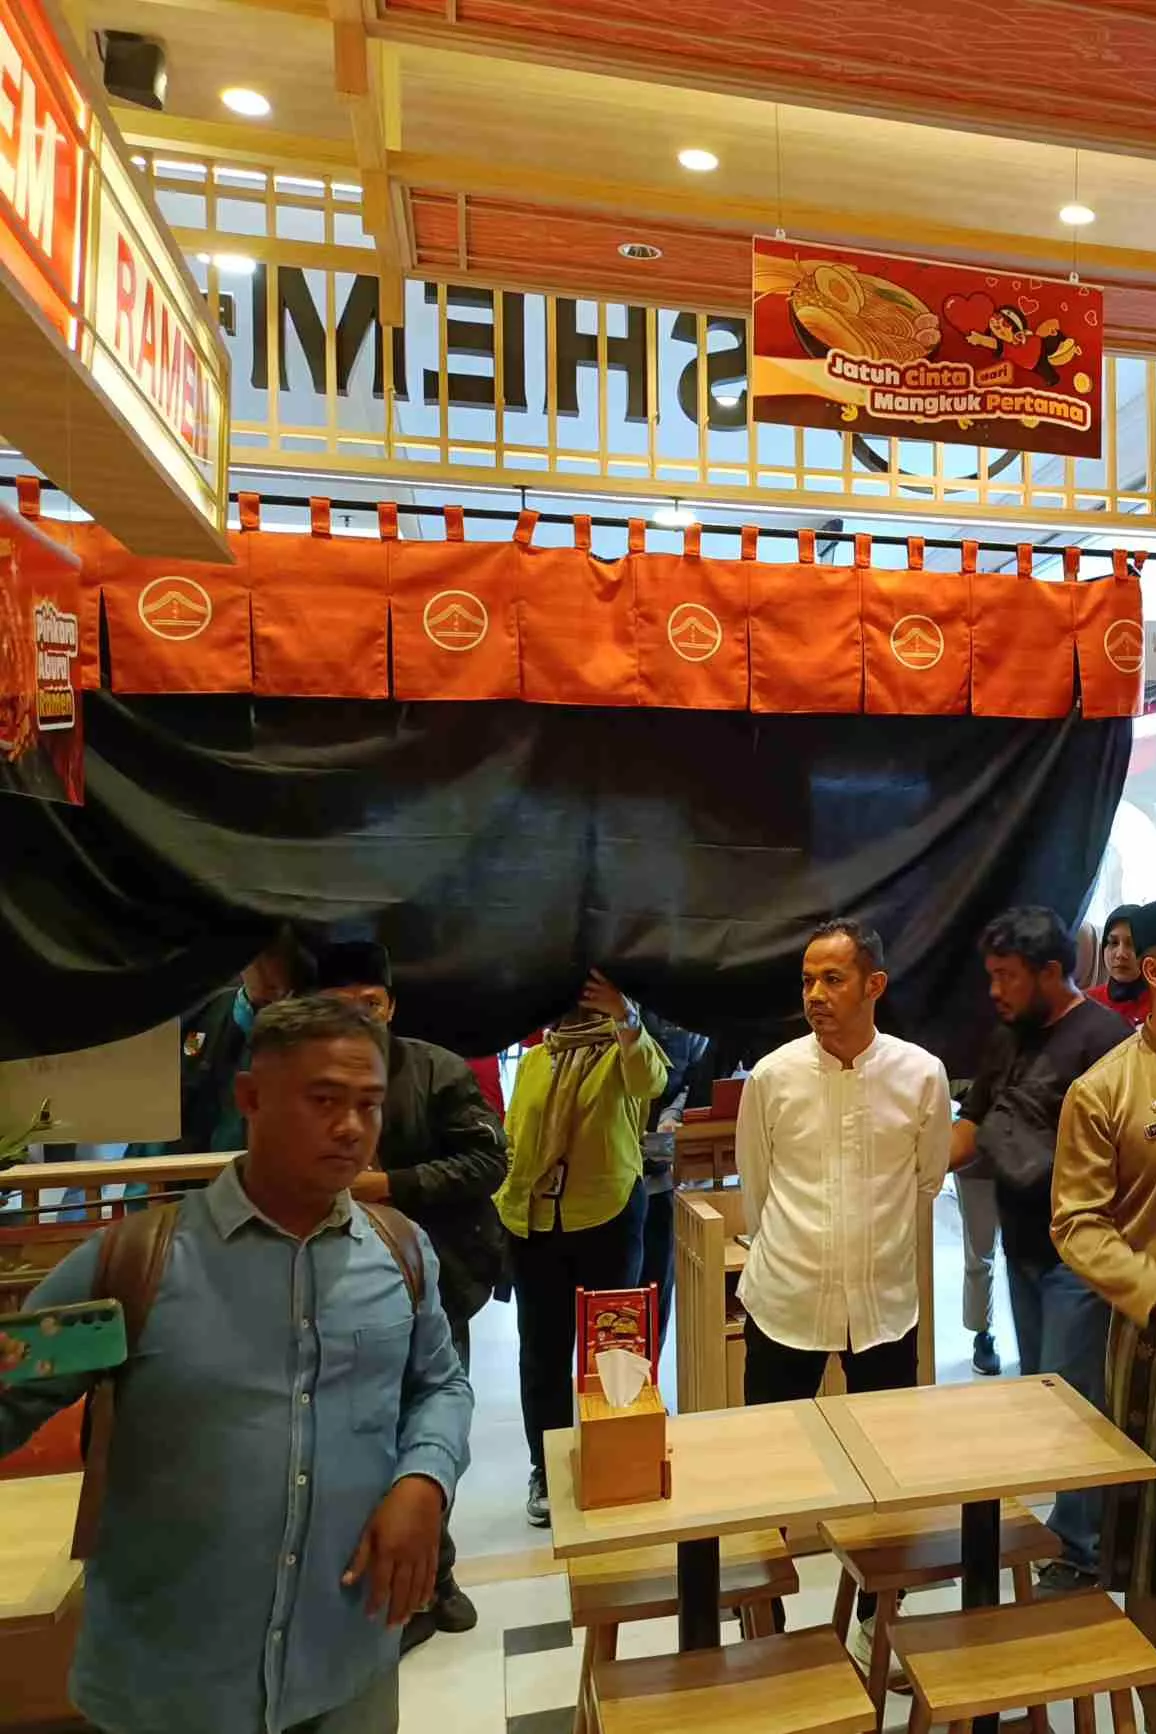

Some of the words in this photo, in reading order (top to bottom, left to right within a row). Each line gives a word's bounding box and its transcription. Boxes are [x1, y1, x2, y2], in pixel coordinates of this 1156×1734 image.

[114, 231, 210, 466] RAMEN
[831, 356, 900, 385] Jatuh
[905, 366, 968, 387] Cinta
[874, 391, 981, 414] Mangkuk
[986, 393, 1084, 422] Pertama
